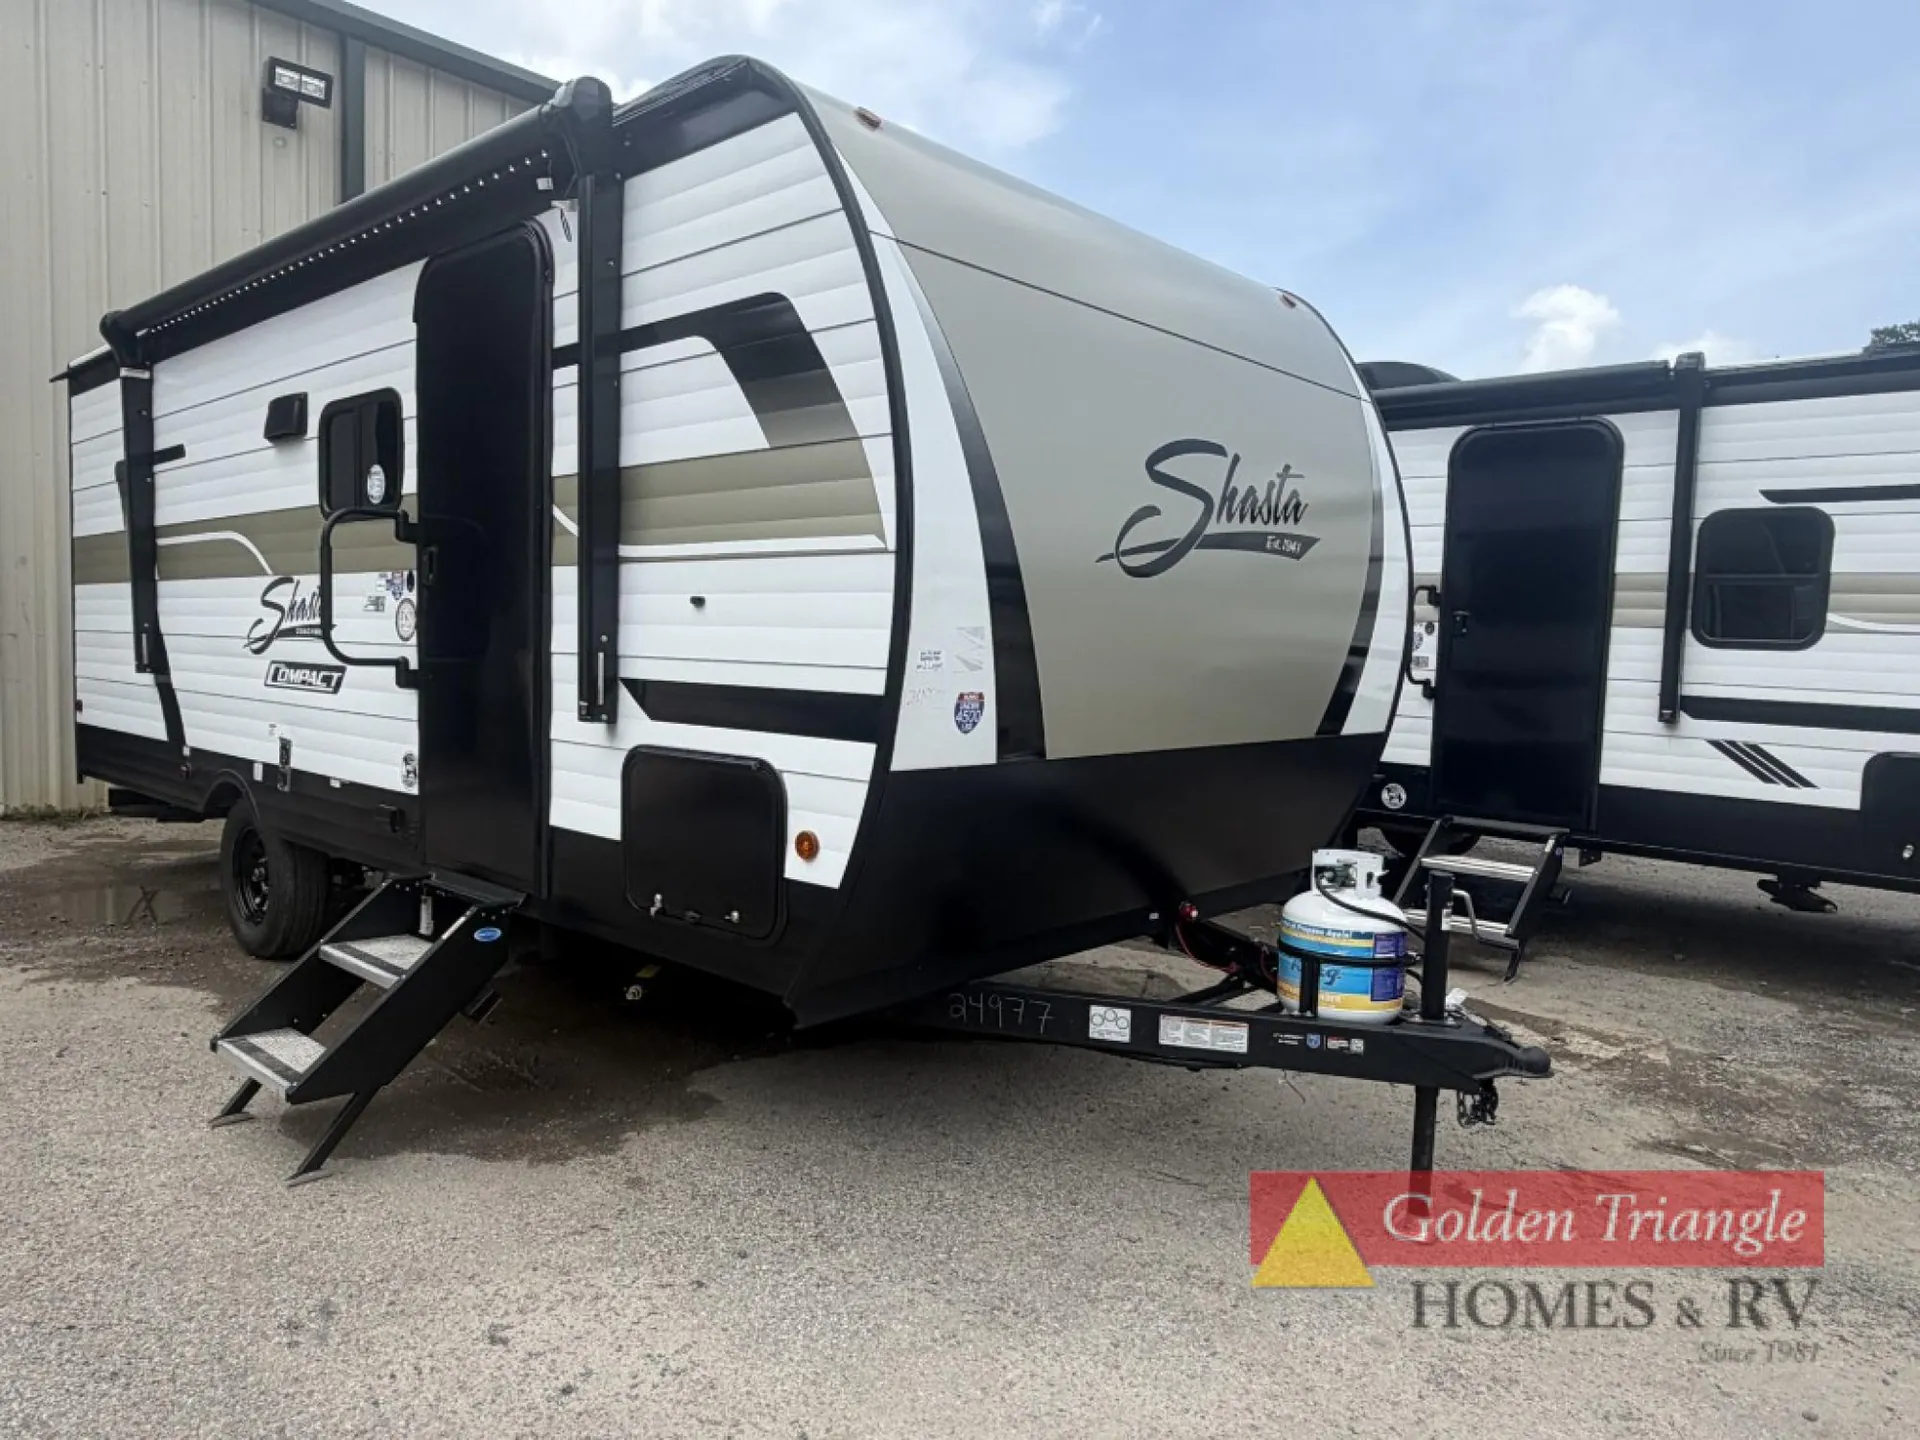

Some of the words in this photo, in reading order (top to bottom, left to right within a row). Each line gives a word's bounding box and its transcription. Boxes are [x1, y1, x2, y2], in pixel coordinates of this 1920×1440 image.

[1114, 438, 1309, 578] Shasta
[247, 577, 321, 655] Shast
[267, 663, 342, 688] COMPACT
